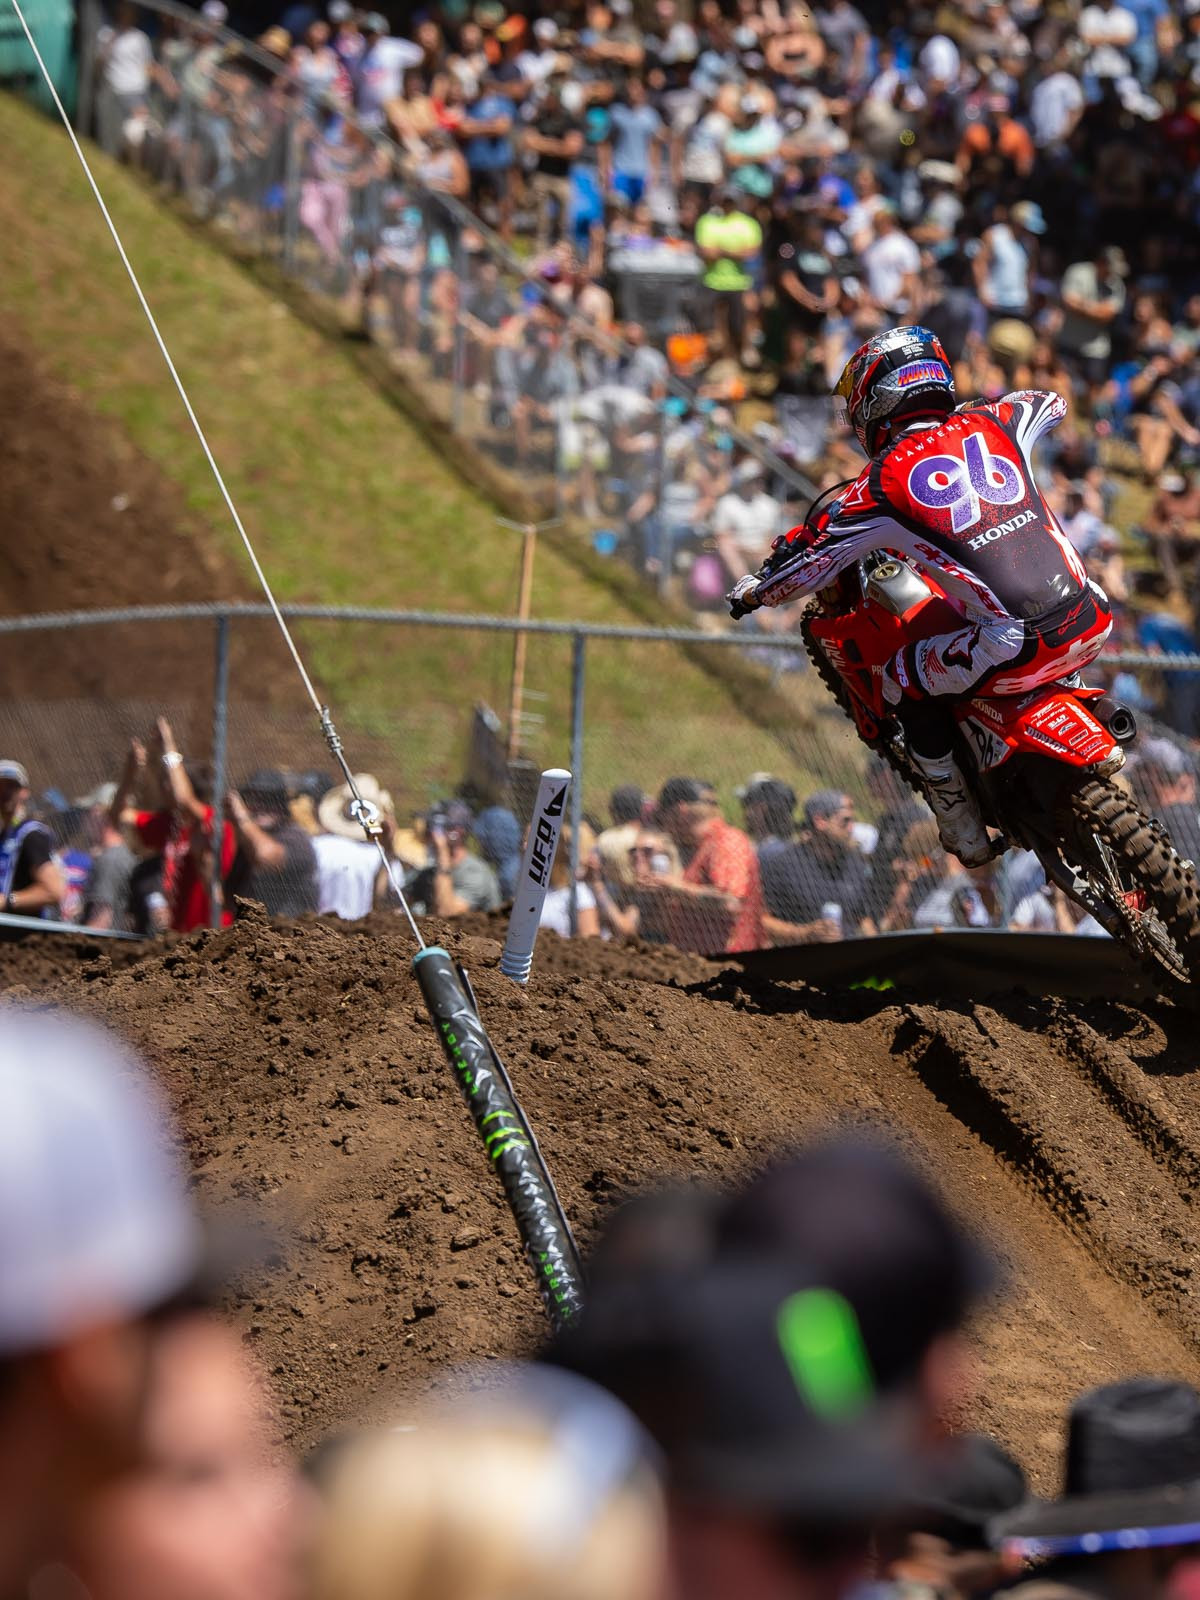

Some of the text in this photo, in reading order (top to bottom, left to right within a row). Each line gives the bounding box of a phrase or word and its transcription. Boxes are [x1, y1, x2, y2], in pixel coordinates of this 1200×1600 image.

[895, 418, 971, 462] LAWRENCE
[907, 431, 1026, 534] 96
[967, 509, 1039, 551] HONDA
[528, 816, 552, 885] UFO
[538, 1251, 577, 1328] NERGY
